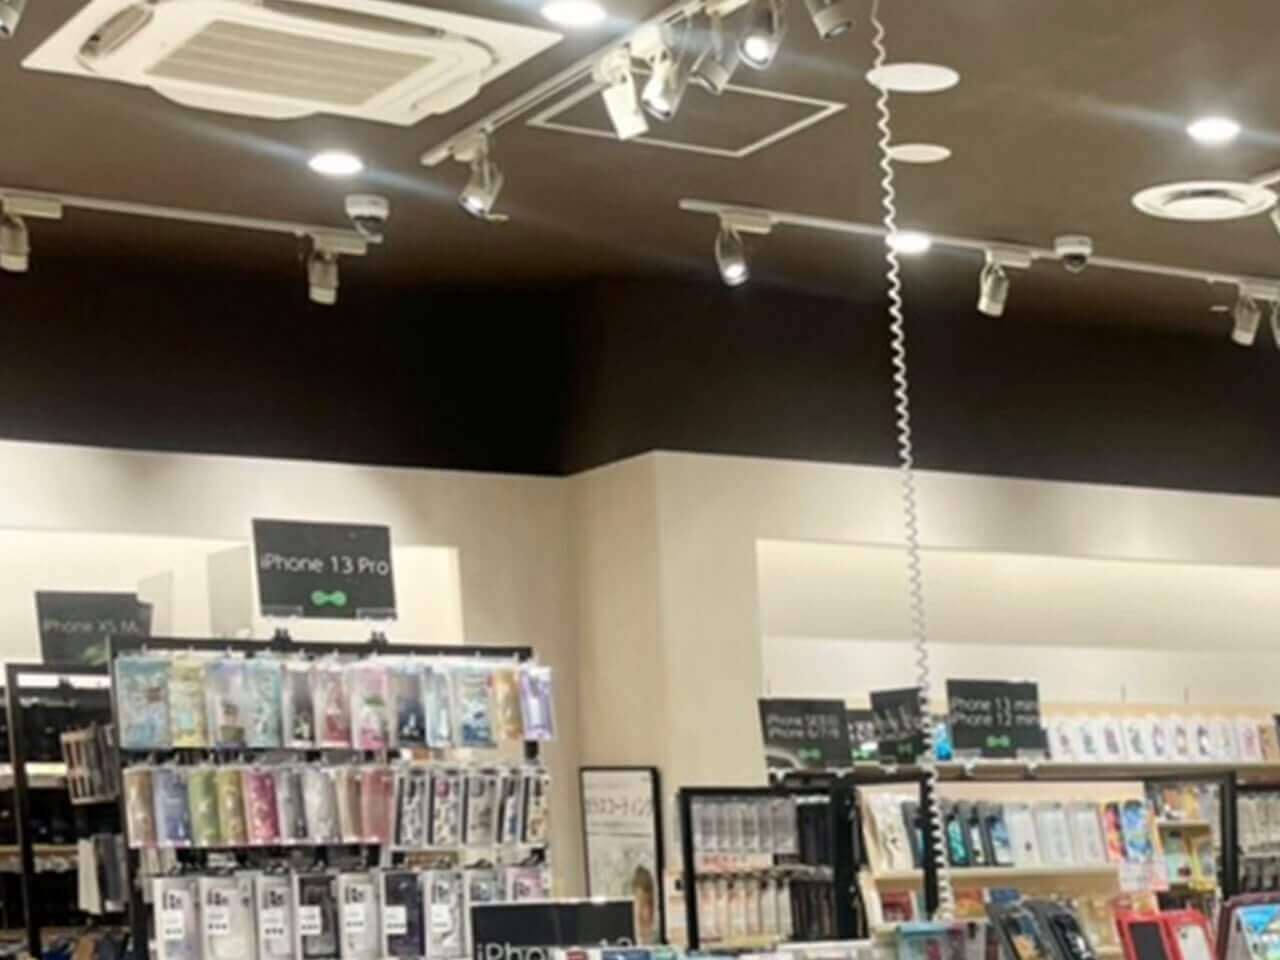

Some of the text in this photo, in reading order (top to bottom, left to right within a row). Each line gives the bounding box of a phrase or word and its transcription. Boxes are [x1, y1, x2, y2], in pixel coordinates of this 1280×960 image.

[260, 553, 389, 576] iPhone 13 Pro
